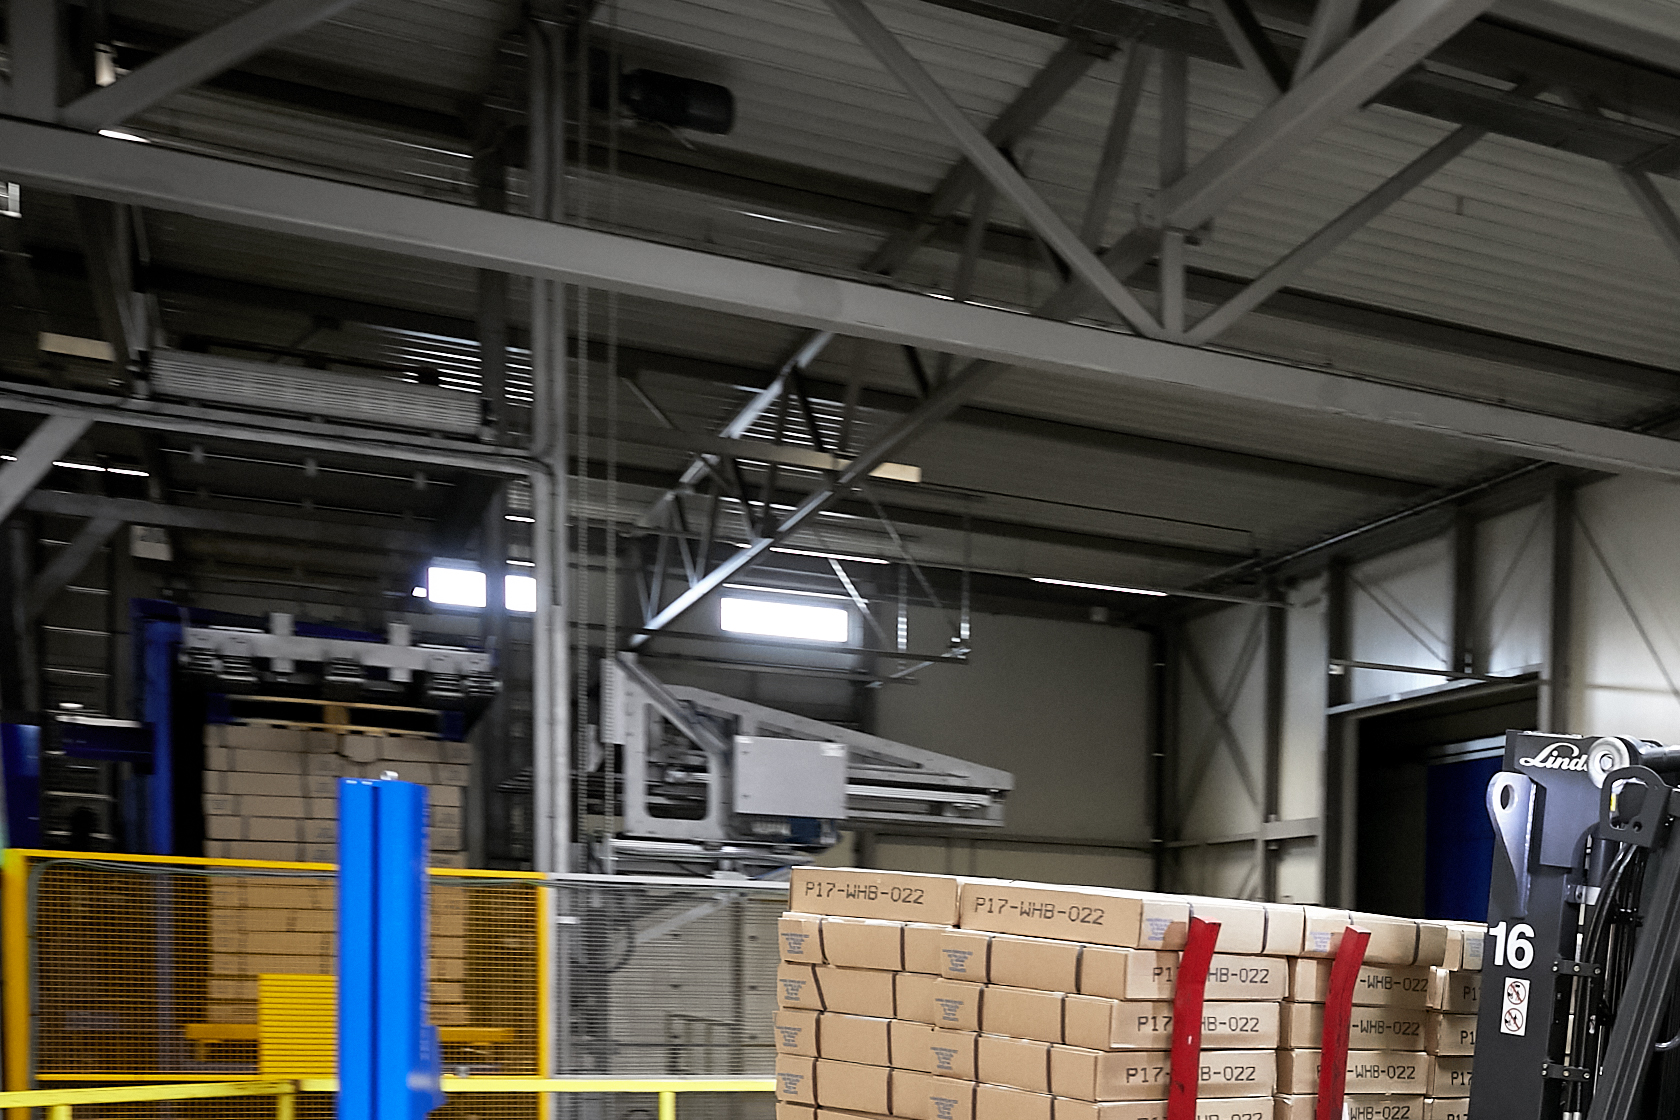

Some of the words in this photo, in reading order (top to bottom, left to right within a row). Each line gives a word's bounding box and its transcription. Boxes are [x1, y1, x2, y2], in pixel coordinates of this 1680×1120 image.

[1519, 742, 1588, 771] Lind
[805, 881, 925, 905] P17-WHB-022
[974, 896, 1105, 926] P17-WHB-022
[1489, 921, 1535, 970] 16
[1152, 967, 1270, 984] P1HB-022
[1137, 1016, 1260, 1033] P17HB-022
[1126, 1066, 1256, 1083] P17-B-022
